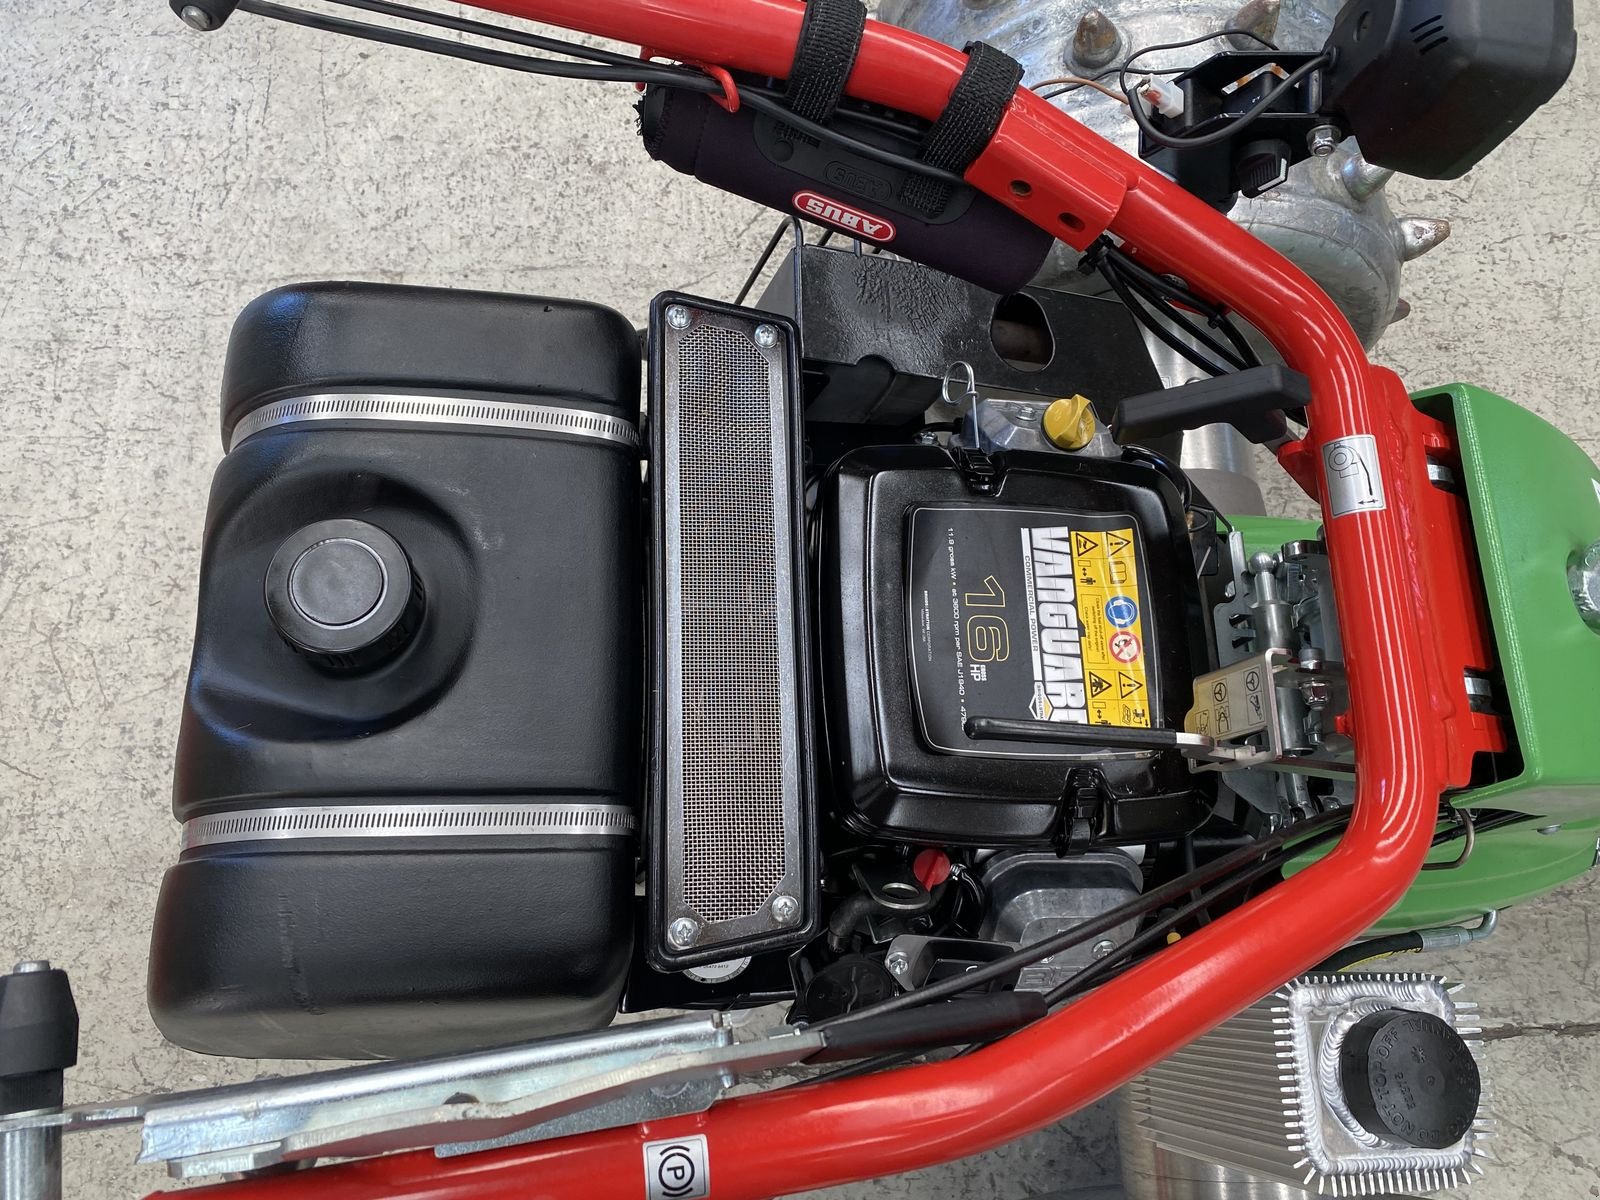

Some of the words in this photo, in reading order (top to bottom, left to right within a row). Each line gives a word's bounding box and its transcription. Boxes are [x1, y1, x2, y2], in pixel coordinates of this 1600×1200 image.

[806, 198, 883, 236] ABUS
[950, 568, 957, 580] kW
[1024, 555, 1036, 616] COMMERCIAL
[951, 588, 958, 598] at
[964, 575, 1010, 662] 16
[1029, 618, 1039, 652] POWER
[955, 651, 963, 668] SAE
[969, 663, 981, 681] HP
[980, 664, 988, 681] GROSS
[957, 669, 965, 696] J1940
[1376, 1026, 1399, 1059] OFF
[1375, 1061, 1390, 1100] TOP
[1382, 1103, 1416, 1136] NOT
[1418, 1128, 1440, 1141] DO
[667, 1165, 685, 1180] P
